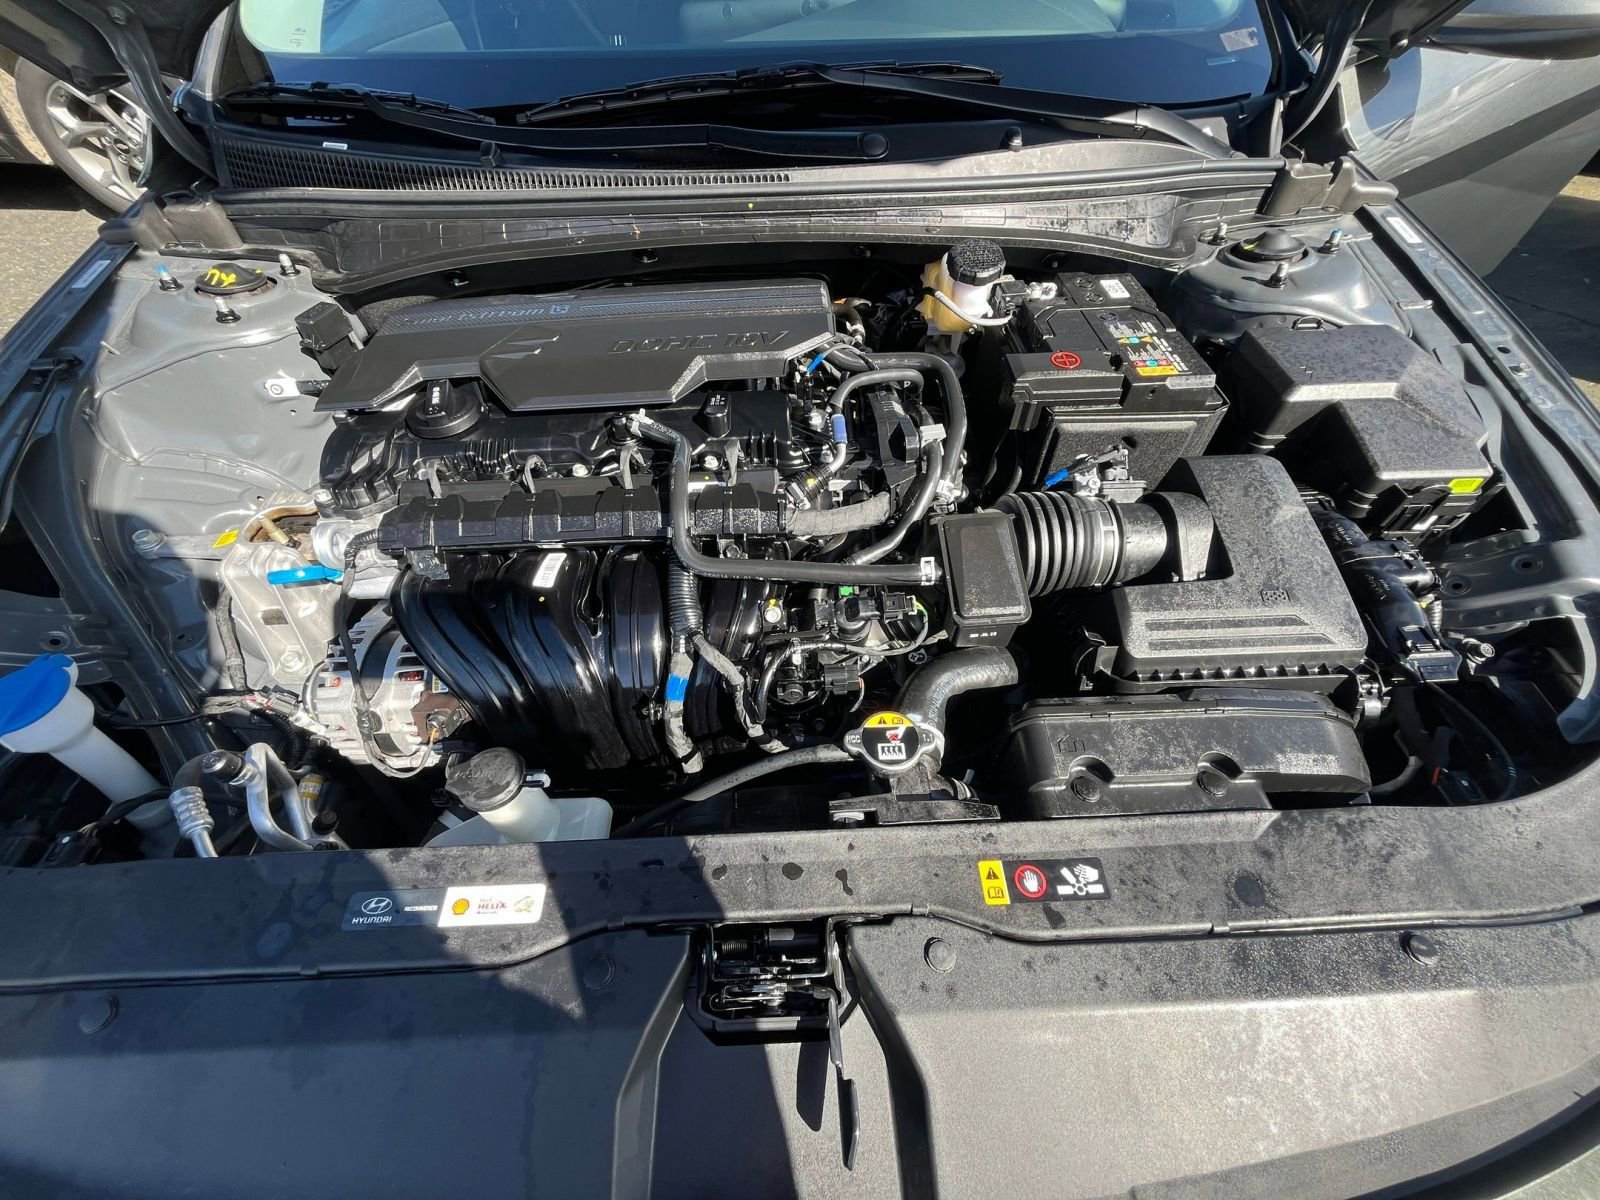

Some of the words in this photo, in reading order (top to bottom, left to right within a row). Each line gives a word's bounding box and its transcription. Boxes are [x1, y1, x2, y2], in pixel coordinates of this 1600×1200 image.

[608, 334, 718, 354] DOHC
[477, 901, 507, 909] HELIX
[352, 916, 392, 924] HYUNDAI
